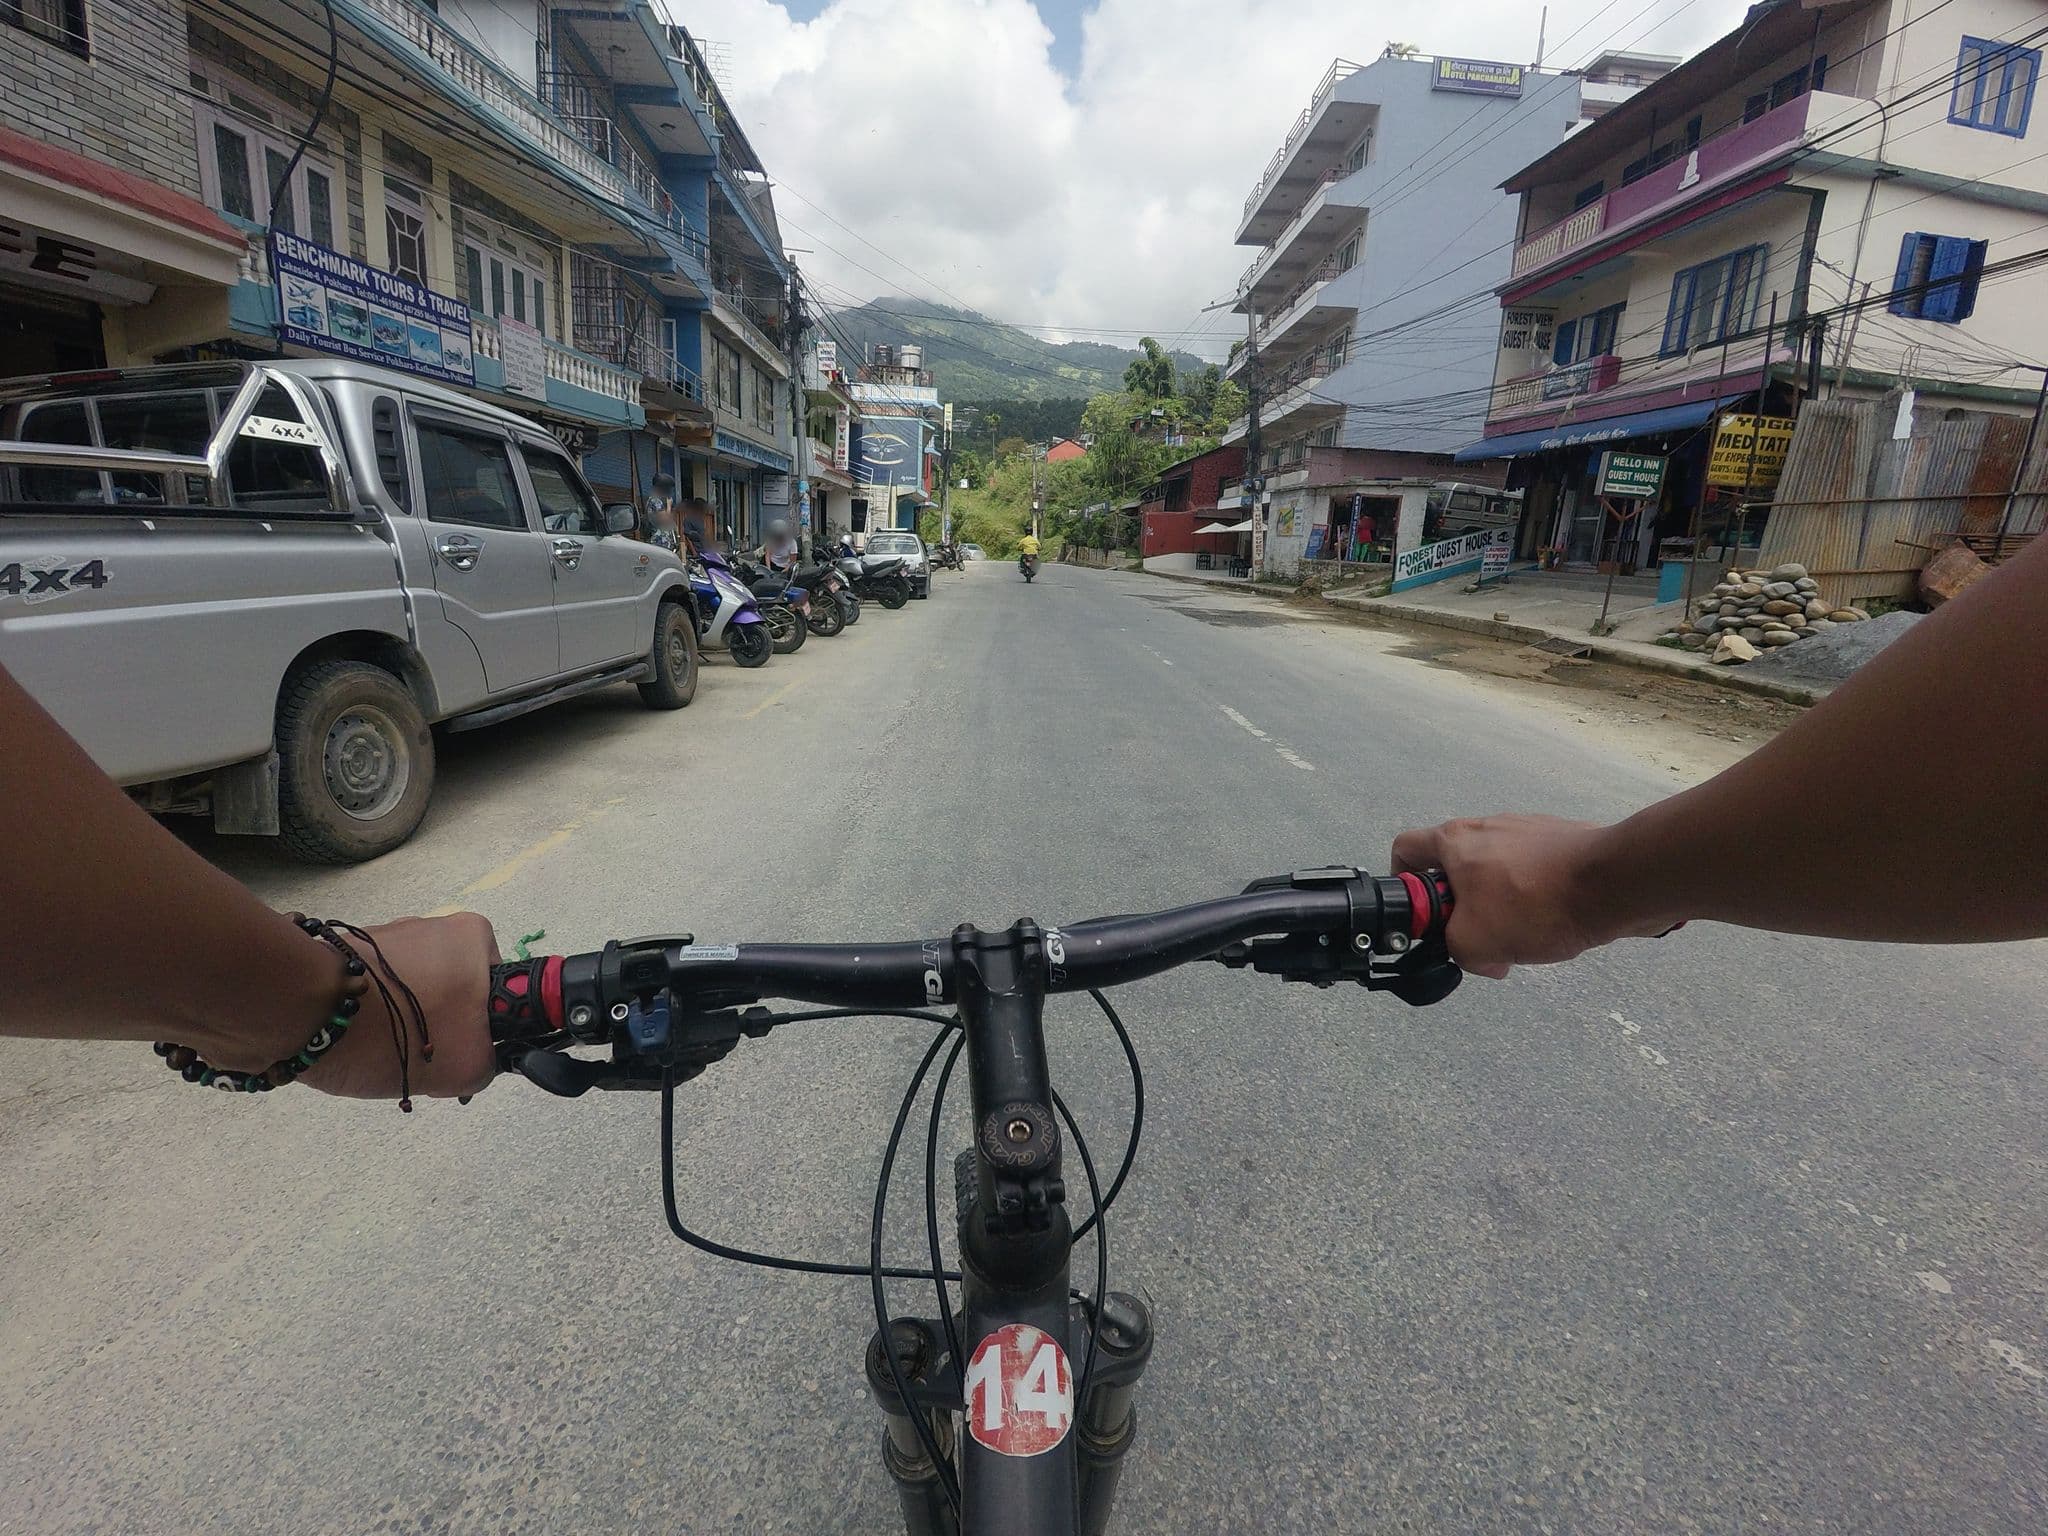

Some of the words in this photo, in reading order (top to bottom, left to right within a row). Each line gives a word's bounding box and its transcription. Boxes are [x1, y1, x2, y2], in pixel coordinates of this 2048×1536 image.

[275, 231, 370, 287] BENCHMARK
[371, 271, 415, 303] TOURS
[418, 290, 427, 307] &
[428, 293, 470, 322] TRAVEL
[1507, 311, 1533, 325] FOREST
[1535, 312, 1553, 327] VIEW
[288, 328, 310, 345] Daily
[310, 335, 341, 351] Tourist
[343, 343, 357, 355] Bus
[359, 347, 385, 363] Service
[1503, 330, 1527, 349] GUEST
[1737, 416, 1796, 431] YOGA
[718, 433, 734, 449] Blue
[736, 440, 747, 457] Sky
[1717, 432, 1791, 453] MEDTATI
[1613, 457, 1641, 469] HELLO
[1643, 459, 1660, 470] INN
[1713, 452, 1723, 461] BY
[1608, 470, 1632, 481] GUEST
[1634, 471, 1659, 483] HOUSE
[1398, 546, 1435, 572] FOREST
[1436, 538, 1463, 560] GUEST
[1465, 531, 1493, 553] HOUSE
[1406, 556, 1435, 576] VIEW
[966, 1343, 1067, 1431] 14
